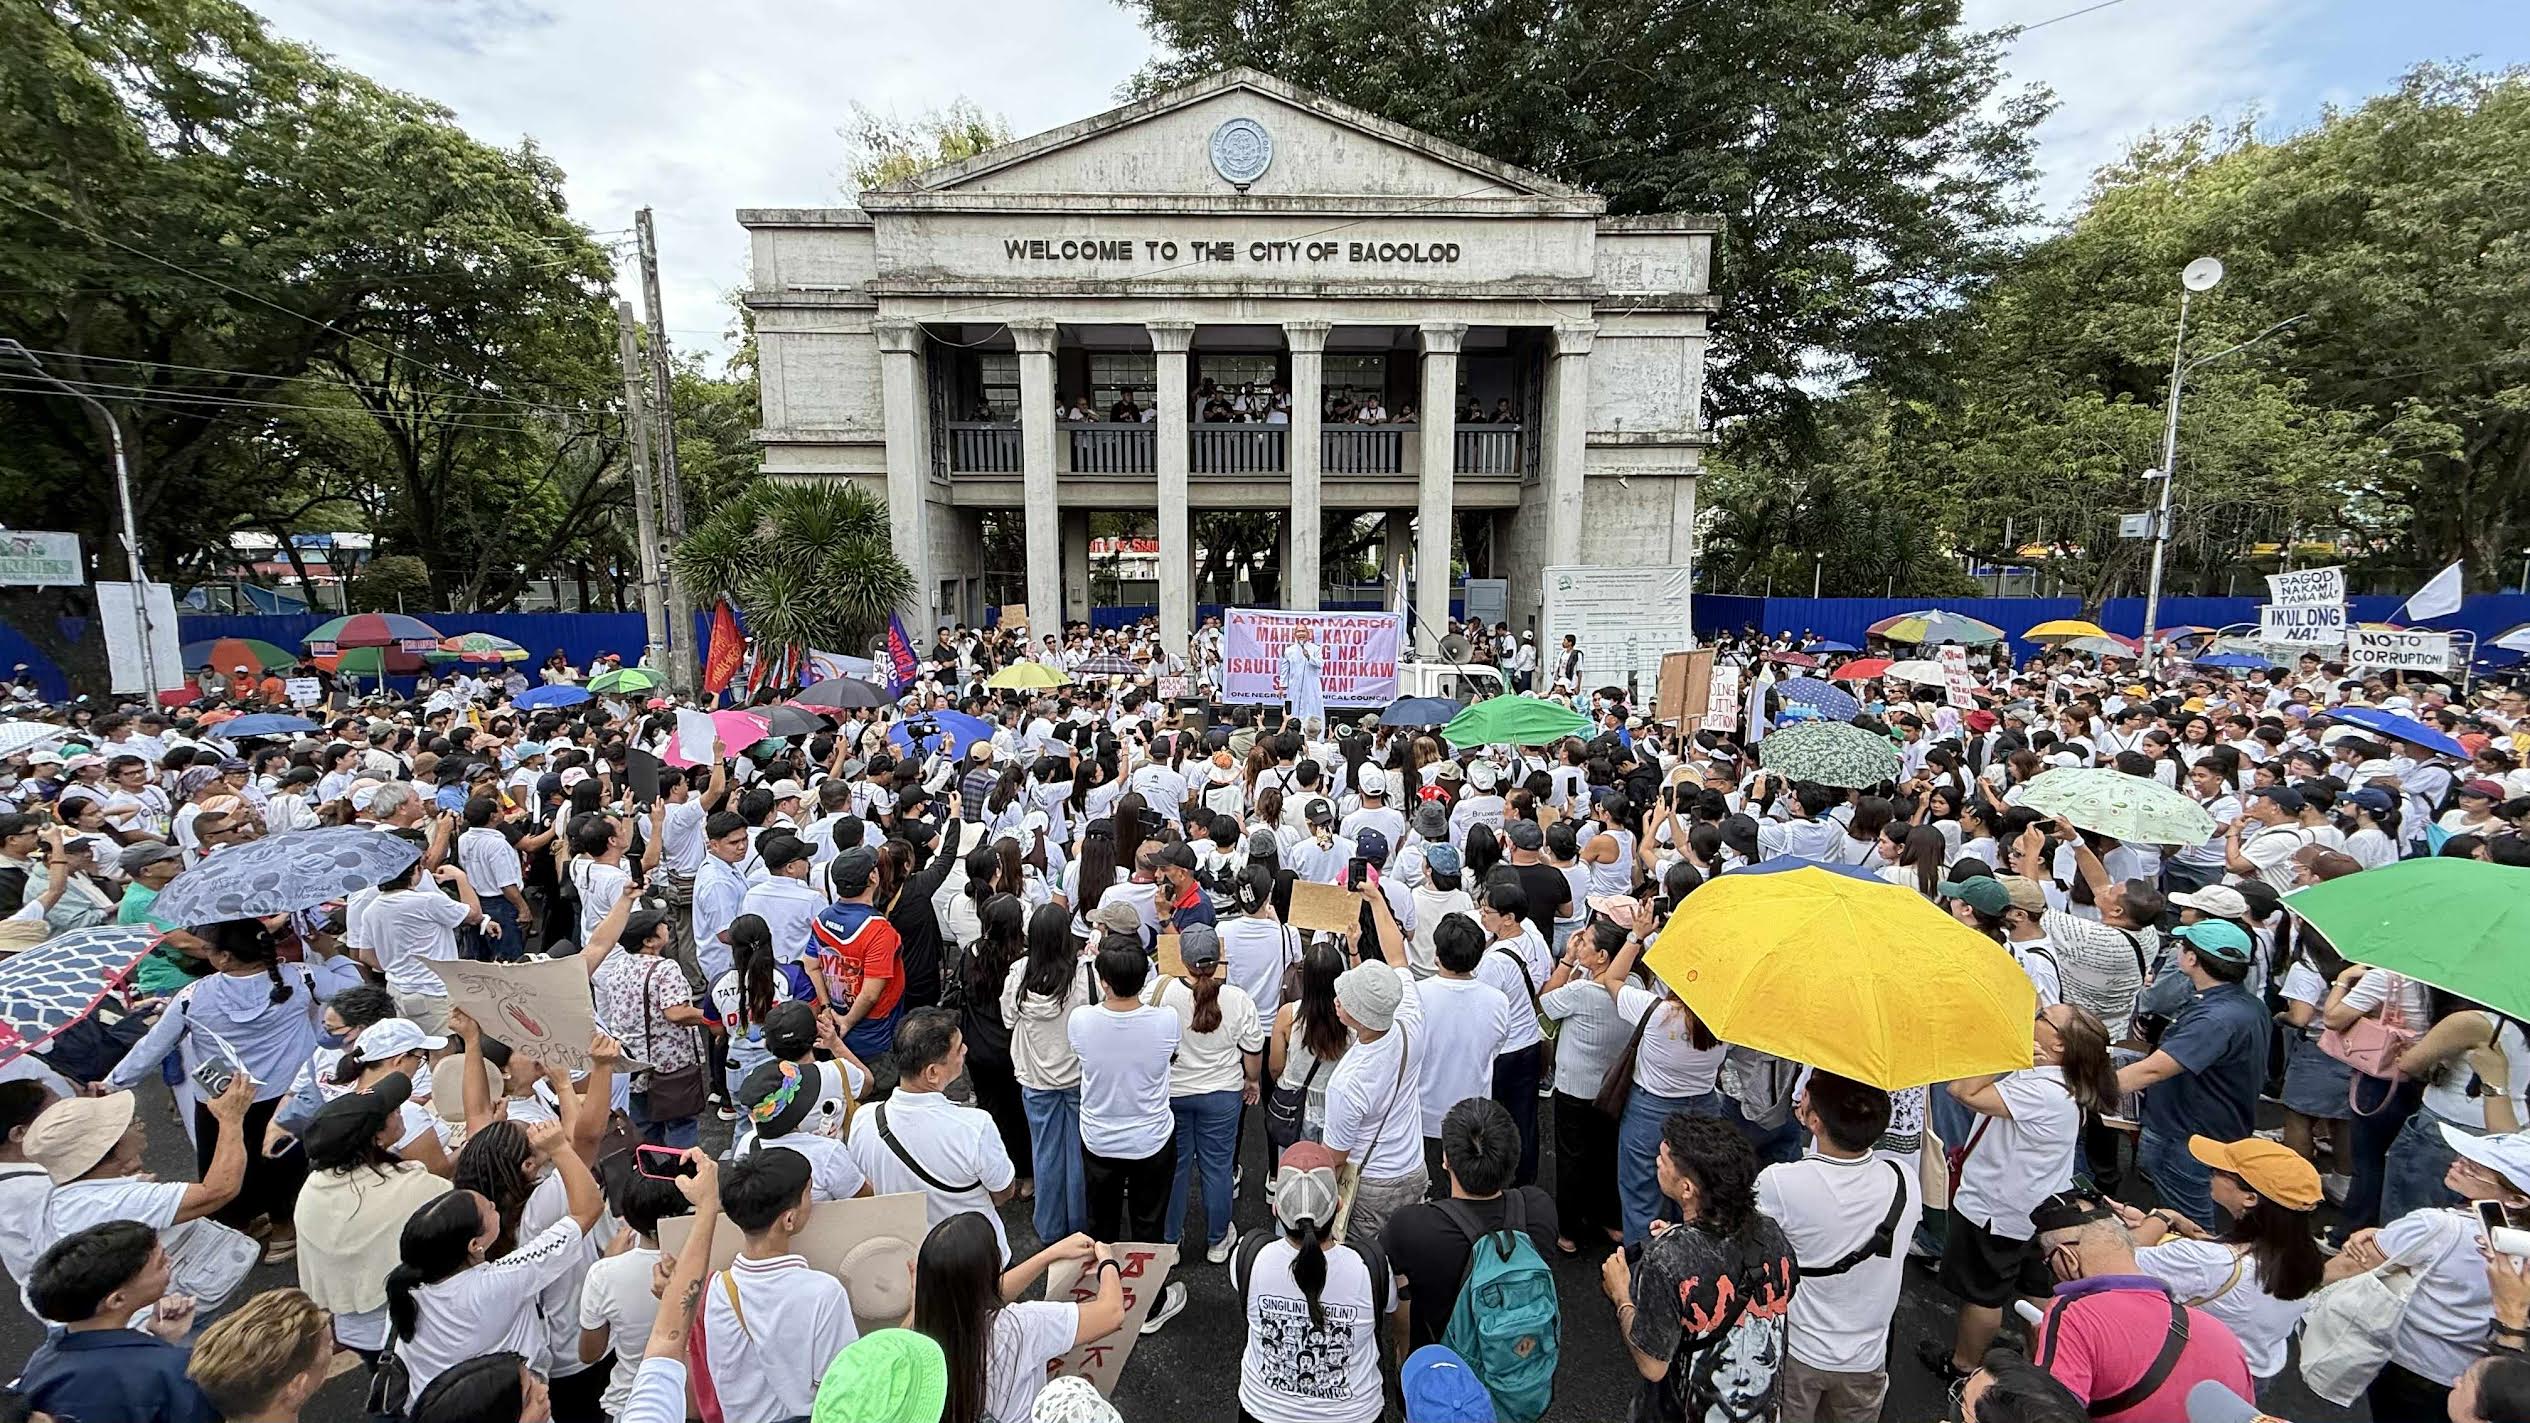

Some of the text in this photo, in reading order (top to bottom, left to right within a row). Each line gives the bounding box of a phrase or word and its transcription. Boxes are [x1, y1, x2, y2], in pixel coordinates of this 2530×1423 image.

[1004, 240, 1461, 262] WELCOME TO THE CITY OF BACOLOD
[2279, 570, 2334, 587] PAGOD
[1248, 616, 1324, 627] TRILLION
[2271, 608, 2340, 626] IKULONG
[1323, 629, 1369, 645] KAYO!
[2284, 627, 2319, 640] NA!
[2360, 633, 2421, 647] NO TO
[1339, 645, 1364, 660] NA!
[2352, 650, 2442, 665] CORRUPTION!
[1228, 658, 1395, 677] ISAULI NINAKAW
[1262, 1298, 1306, 1315] SINGILIN!
